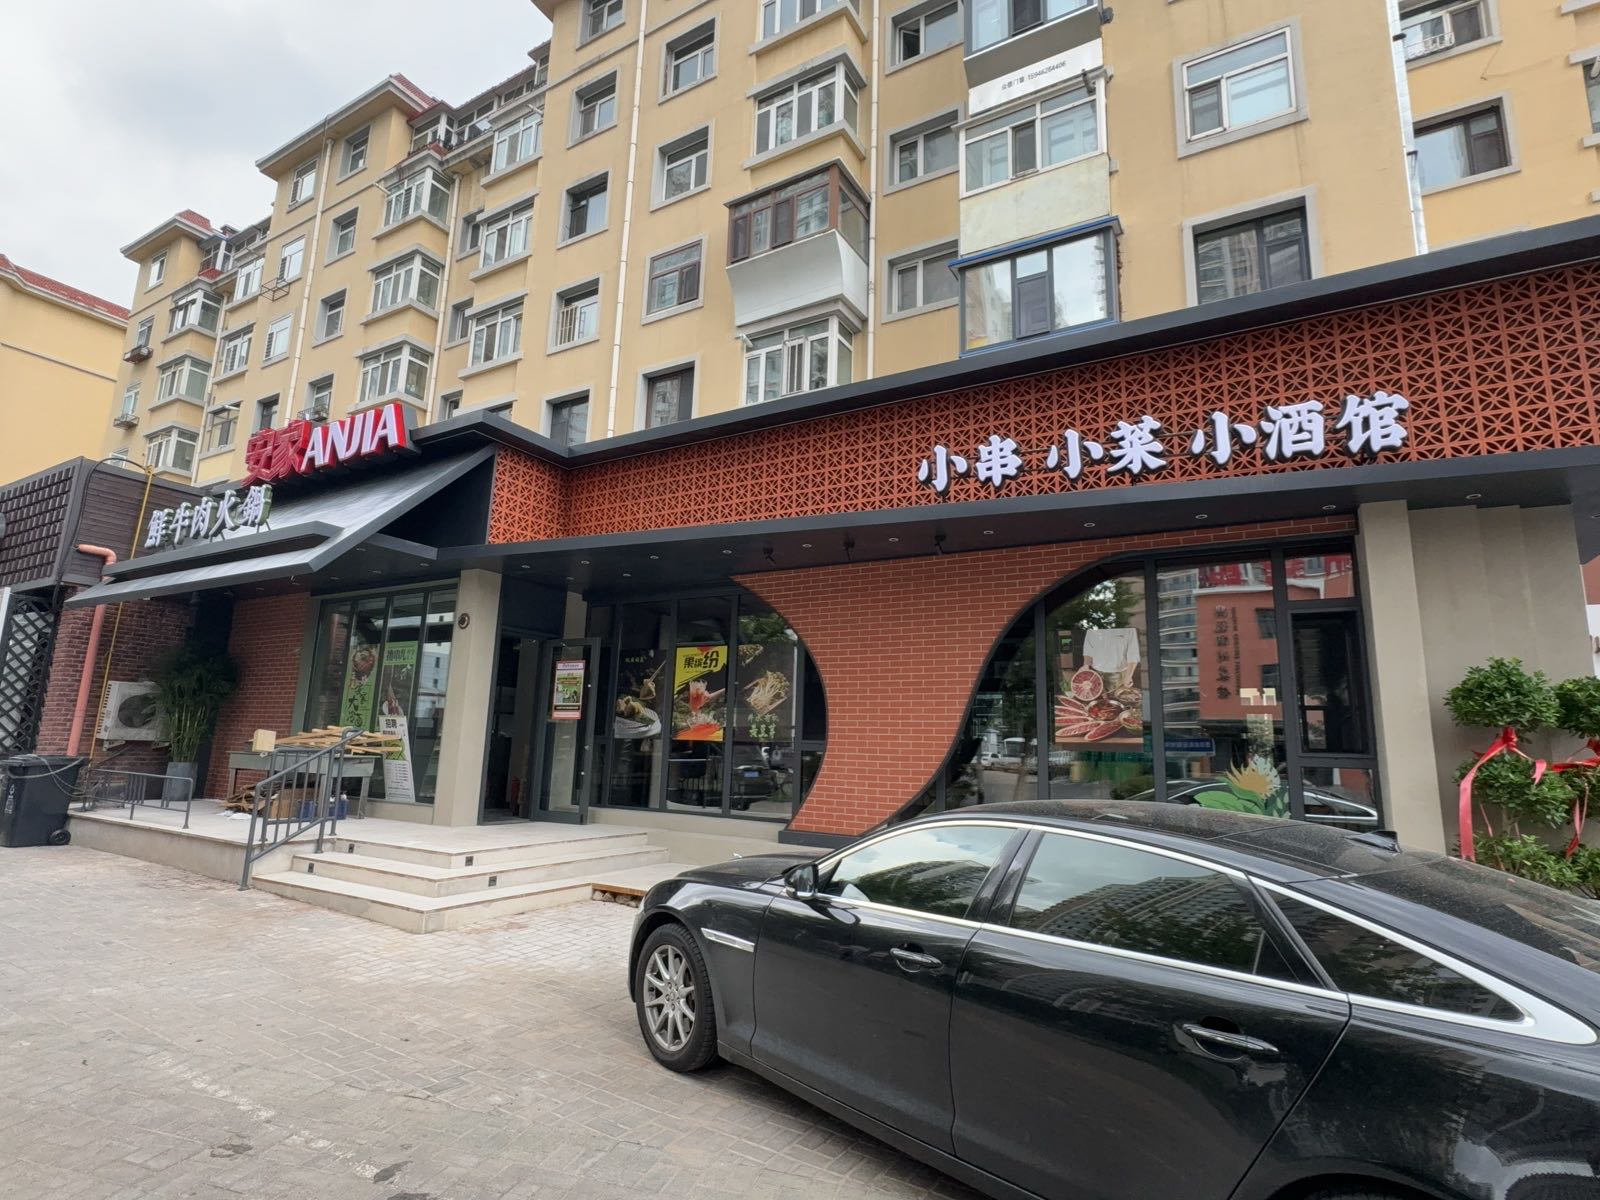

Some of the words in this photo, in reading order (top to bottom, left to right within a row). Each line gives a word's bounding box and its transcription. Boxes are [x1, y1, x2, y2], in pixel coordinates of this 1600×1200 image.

[301, 402, 404, 474] ANJIA
[918, 434, 1023, 494] 小串
[1047, 414, 1167, 480] 小菜
[1191, 390, 1410, 466] 小酒馆
